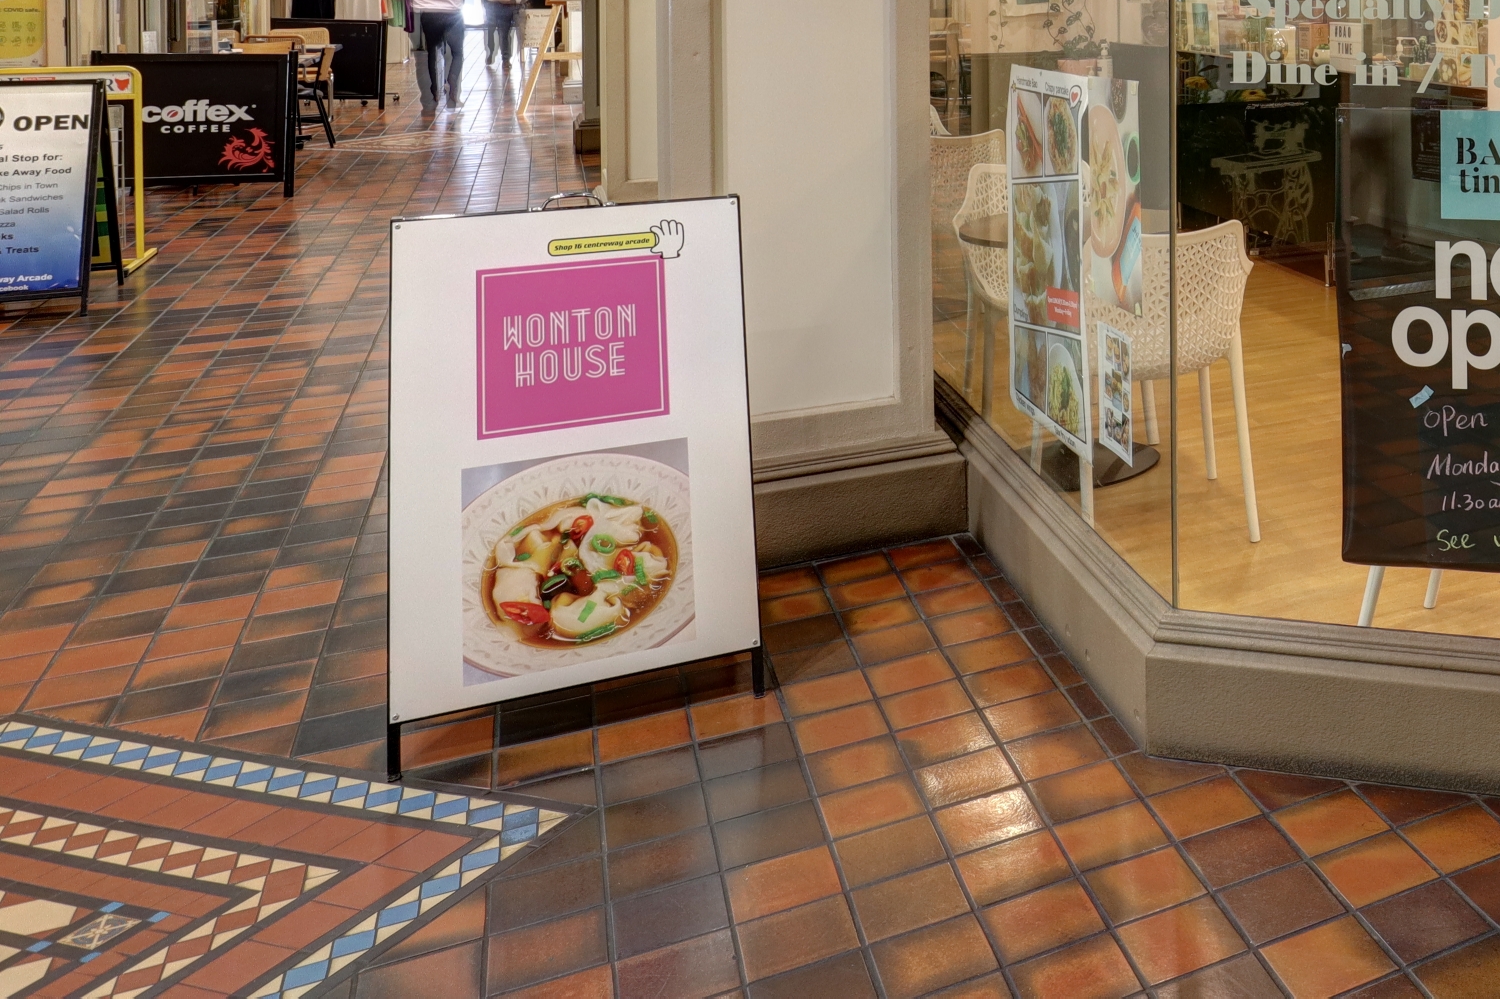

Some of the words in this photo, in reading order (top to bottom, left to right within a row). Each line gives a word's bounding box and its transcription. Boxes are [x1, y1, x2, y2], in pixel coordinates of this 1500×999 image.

[1334, 25, 1352, 39] #BAO
[1337, 42, 1353, 55] TIME
[1230, 50, 1339, 91] Dine
[1352, 51, 1402, 88] in
[141, 99, 255, 123] coffex
[13, 114, 90, 131] OPEN
[160, 124, 231, 134] COFFEE
[11, 154, 39, 163] Stop
[42, 153, 63, 161] for:
[12, 168, 42, 177] Away
[44, 167, 72, 175] Food
[35, 182, 59, 190] Town
[9, 194, 64, 203] Sandwiches
[27, 206, 50, 214] Rolls
[6, 245, 40, 255] Treats
[554, 244, 573, 252] Shop
[583, 239, 625, 249] centreway
[624, 237, 651, 246] arcade
[16, 273, 54, 282] Arcade
[503, 303, 637, 351] WONTON
[515, 341, 627, 388] HOUSE
[1436, 529, 1476, 552] See
